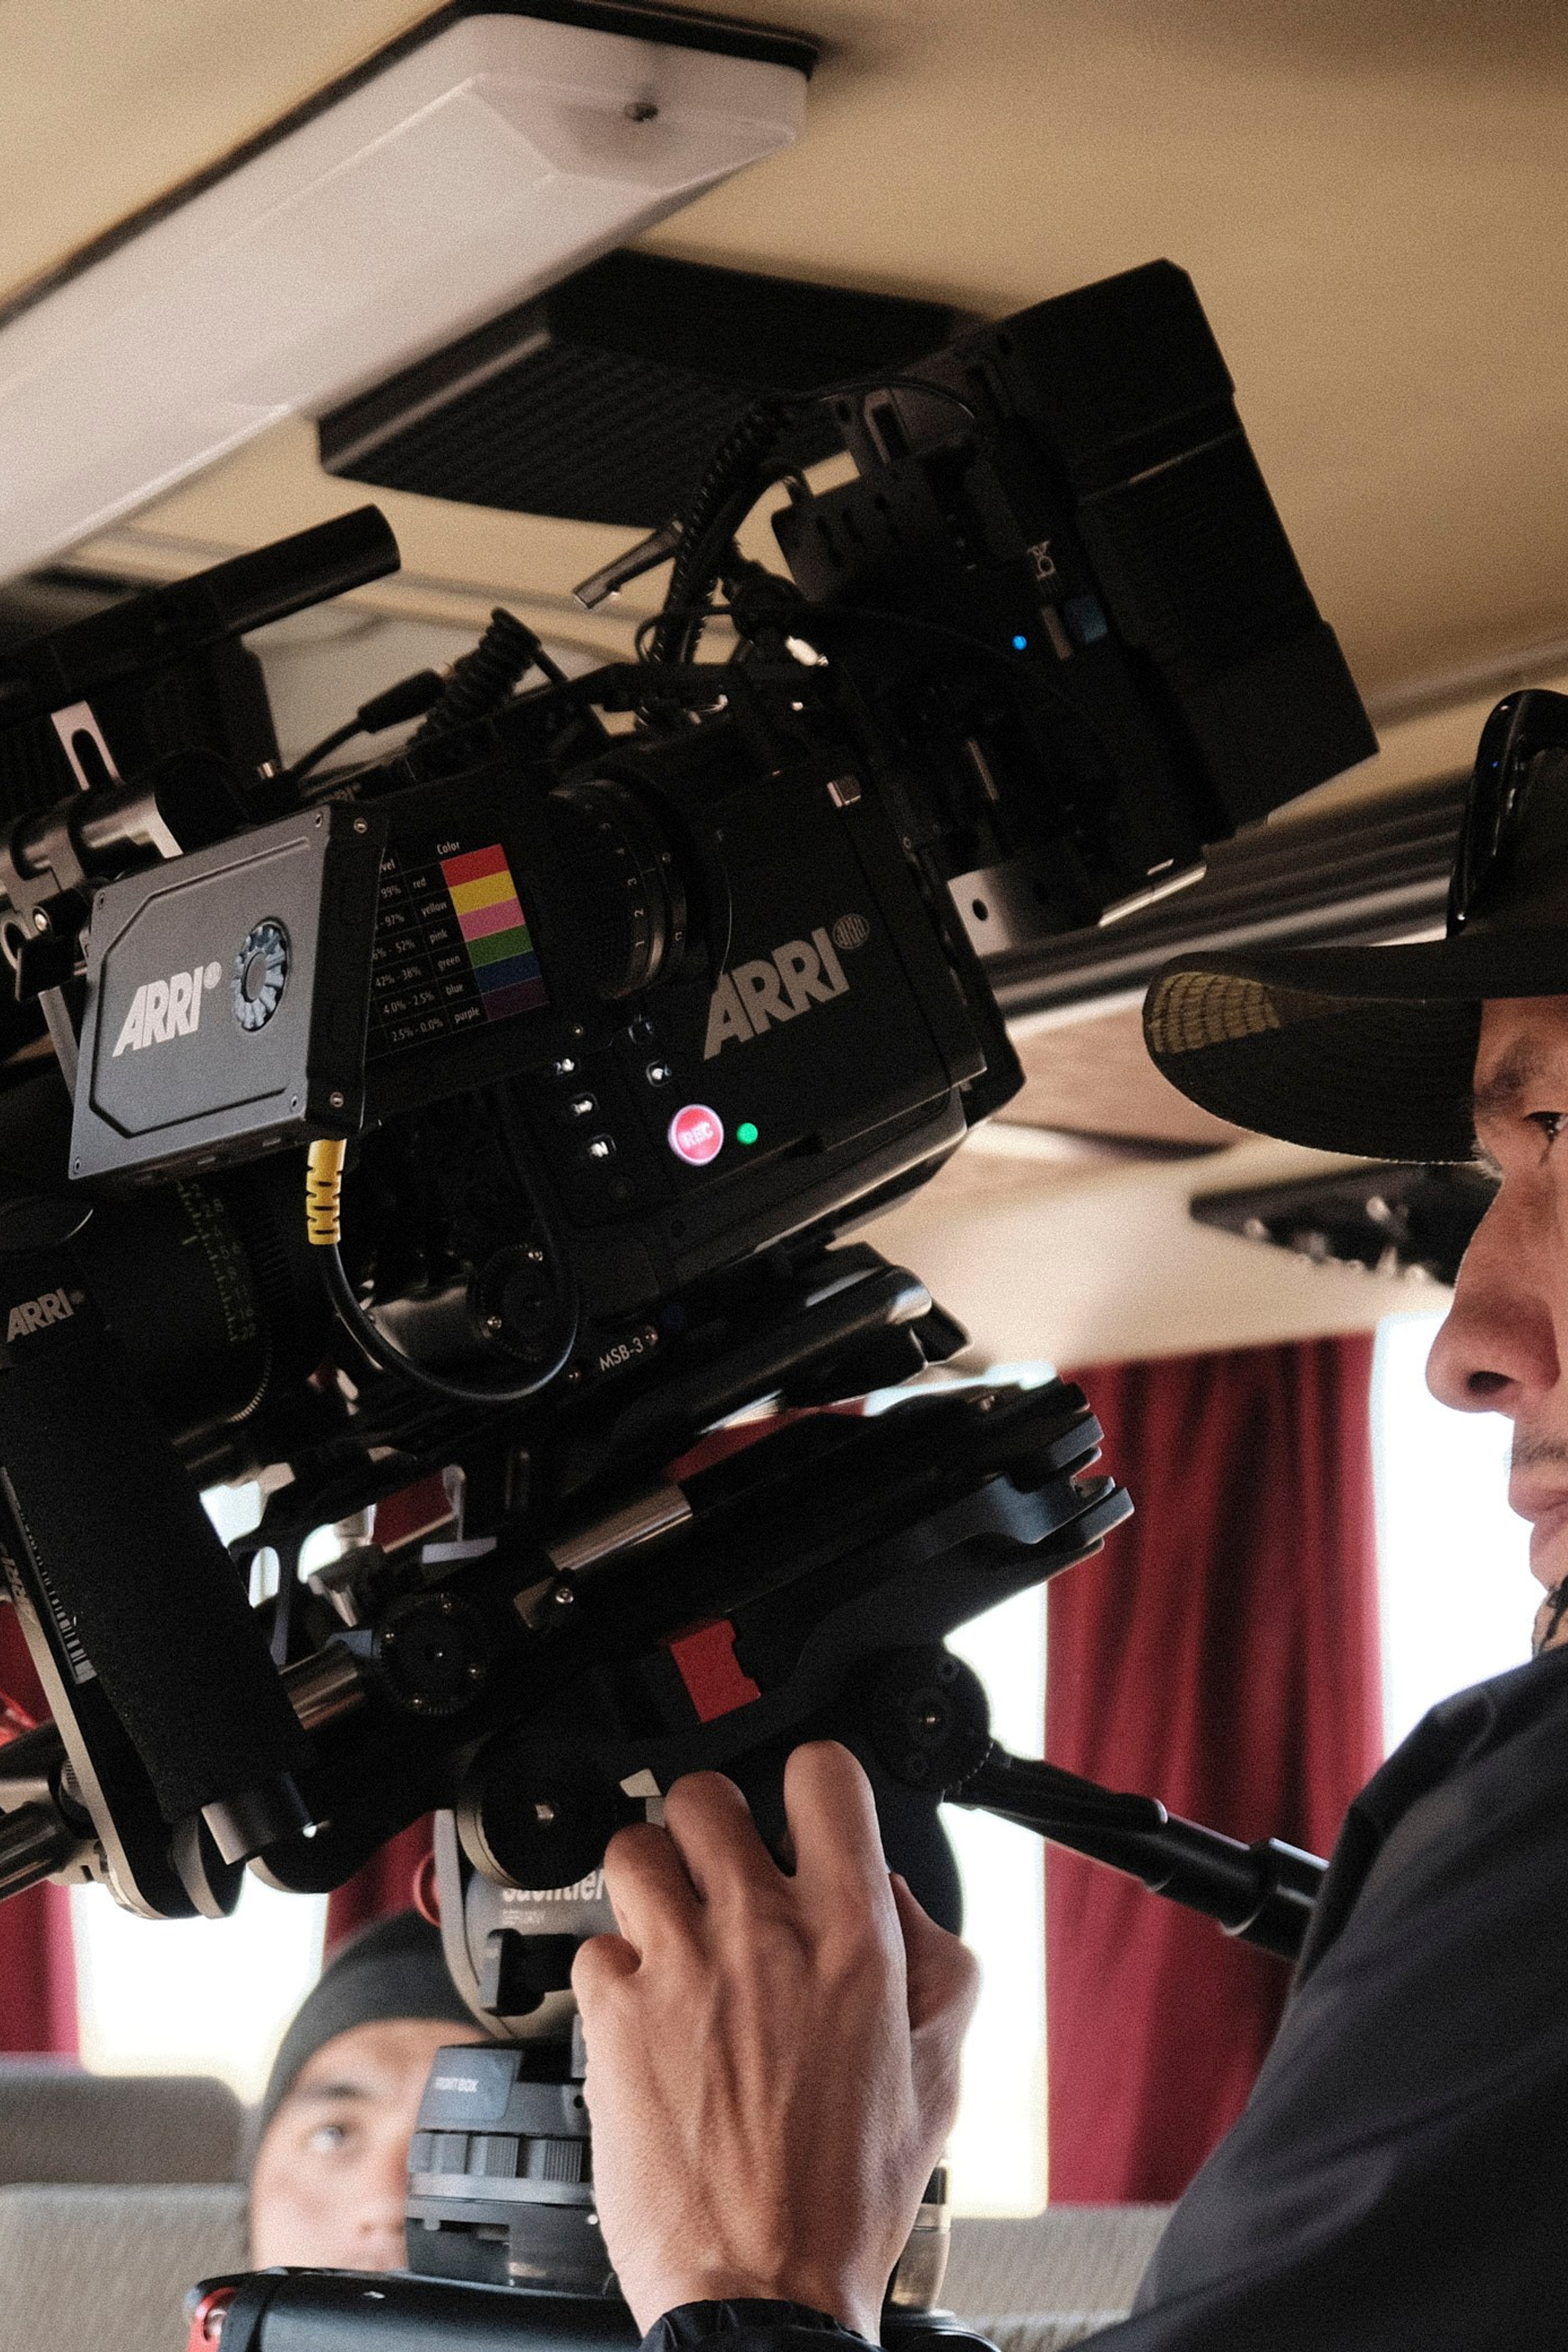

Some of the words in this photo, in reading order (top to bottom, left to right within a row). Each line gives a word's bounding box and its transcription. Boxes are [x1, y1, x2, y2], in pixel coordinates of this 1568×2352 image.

[436, 841, 461, 856] Color
[412, 876, 427, 889] red
[627, 876, 638, 887] 3
[420, 901, 448, 919] yellow
[633, 908, 645, 919] 2
[395, 939, 416, 955] 52%
[429, 929, 448, 945] pink
[437, 955, 461, 972] green
[445, 983, 464, 997] blue
[703, 926, 851, 1062] ARRI
[111, 965, 204, 1058] ARRI
[454, 1006, 480, 1025] purple
[679, 1121, 715, 1149] REC
[6, 1286, 75, 1344] ARRI
[598, 1336, 644, 1373] MSB-3
